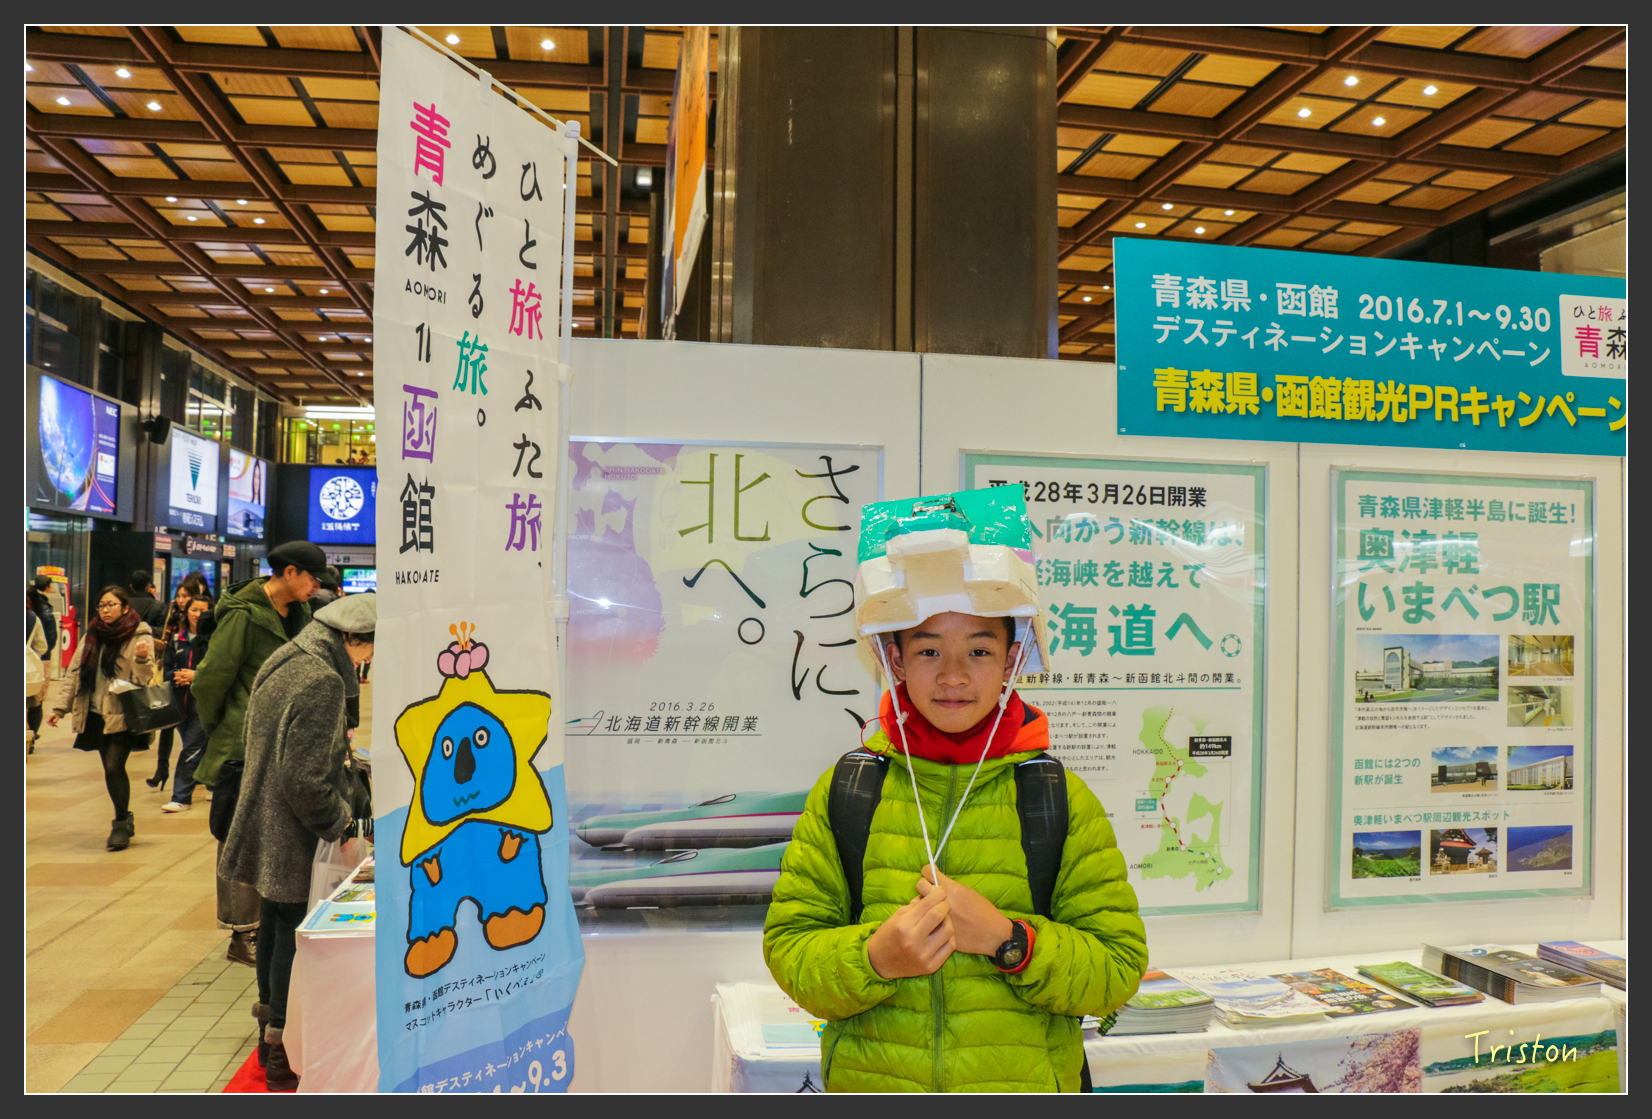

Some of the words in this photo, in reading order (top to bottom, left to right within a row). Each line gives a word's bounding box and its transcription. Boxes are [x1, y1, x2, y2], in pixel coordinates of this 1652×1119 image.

[404, 101, 452, 272] 青森
[404, 278, 447, 304] AOMORI
[453, 133, 498, 428] めぐる旅。
[1151, 272, 1340, 321] 青森県・函館
[1573, 304, 1614, 322] ひと旅
[1152, 314, 1552, 368] デスティネーションキャンペーン
[1574, 324, 1627, 361] 青森
[105, 405, 118, 418] NEC
[1152, 366, 1627, 433] 青森県・函館観光PRキャンペーン
[399, 384, 439, 554] 函館
[988, 479, 1208, 508] 28年3月26日開業
[677, 453, 772, 645] 北へ。
[1356, 527, 1481, 575] 奥津軽
[395, 569, 440, 585] HAKOATE
[790, 454, 867, 730] さらに、
[1357, 580, 1561, 627] いまべつ駅
[605, 714, 760, 733] 北海道新幹線開業
[650, 701, 716, 712] 2016.3.26
[1354, 757, 1422, 771] 函館には2つの
[1354, 773, 1404, 787] 新駅が誕生
[1353, 809, 1511, 828] 奥津軽いまべつ駅周辺観光スポット
